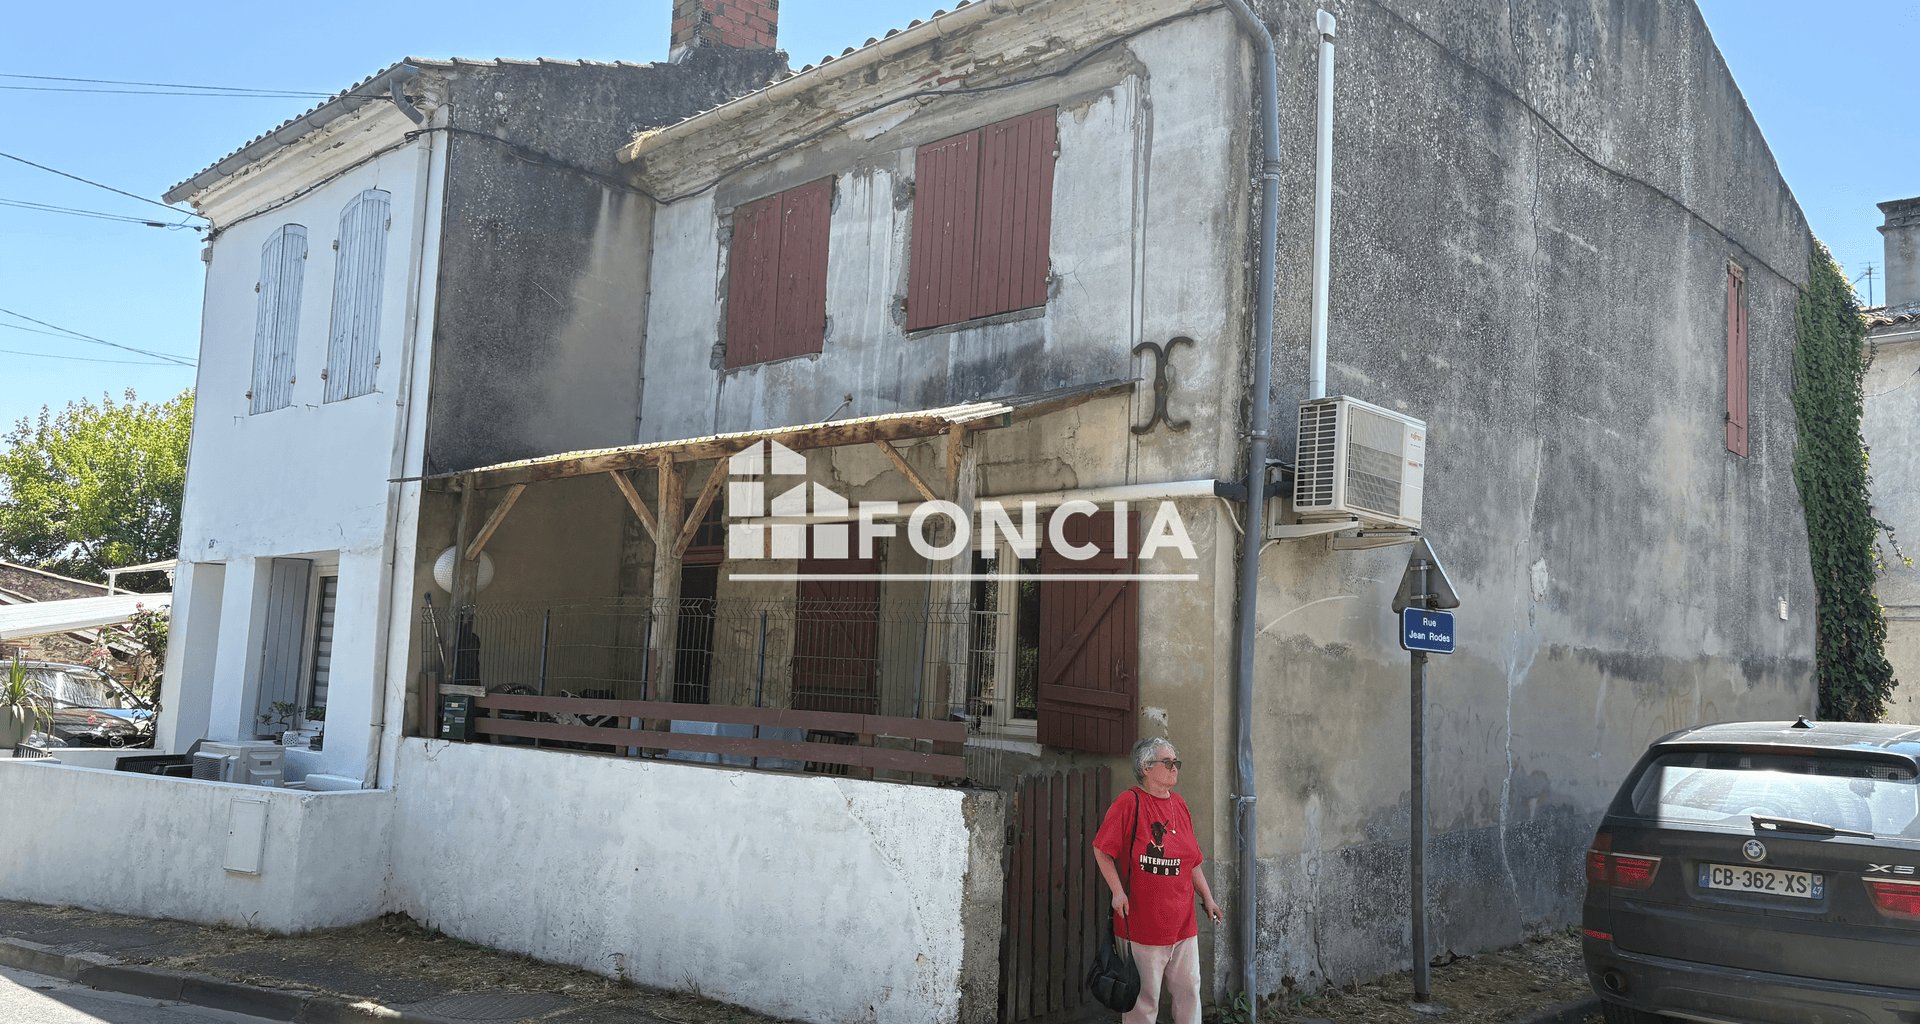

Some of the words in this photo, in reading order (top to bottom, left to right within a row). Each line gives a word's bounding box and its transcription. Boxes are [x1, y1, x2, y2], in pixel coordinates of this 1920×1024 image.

[1422, 617, 1437, 627] Rue
[1408, 630, 1426, 640] Jean
[1429, 632, 1451, 643] Rodes
[1139, 854, 1181, 866] INTERVILLES
[1865, 863, 1915, 875] X5
[1712, 867, 1807, 894] CB-362-XS
[1812, 886, 1823, 895] 47
